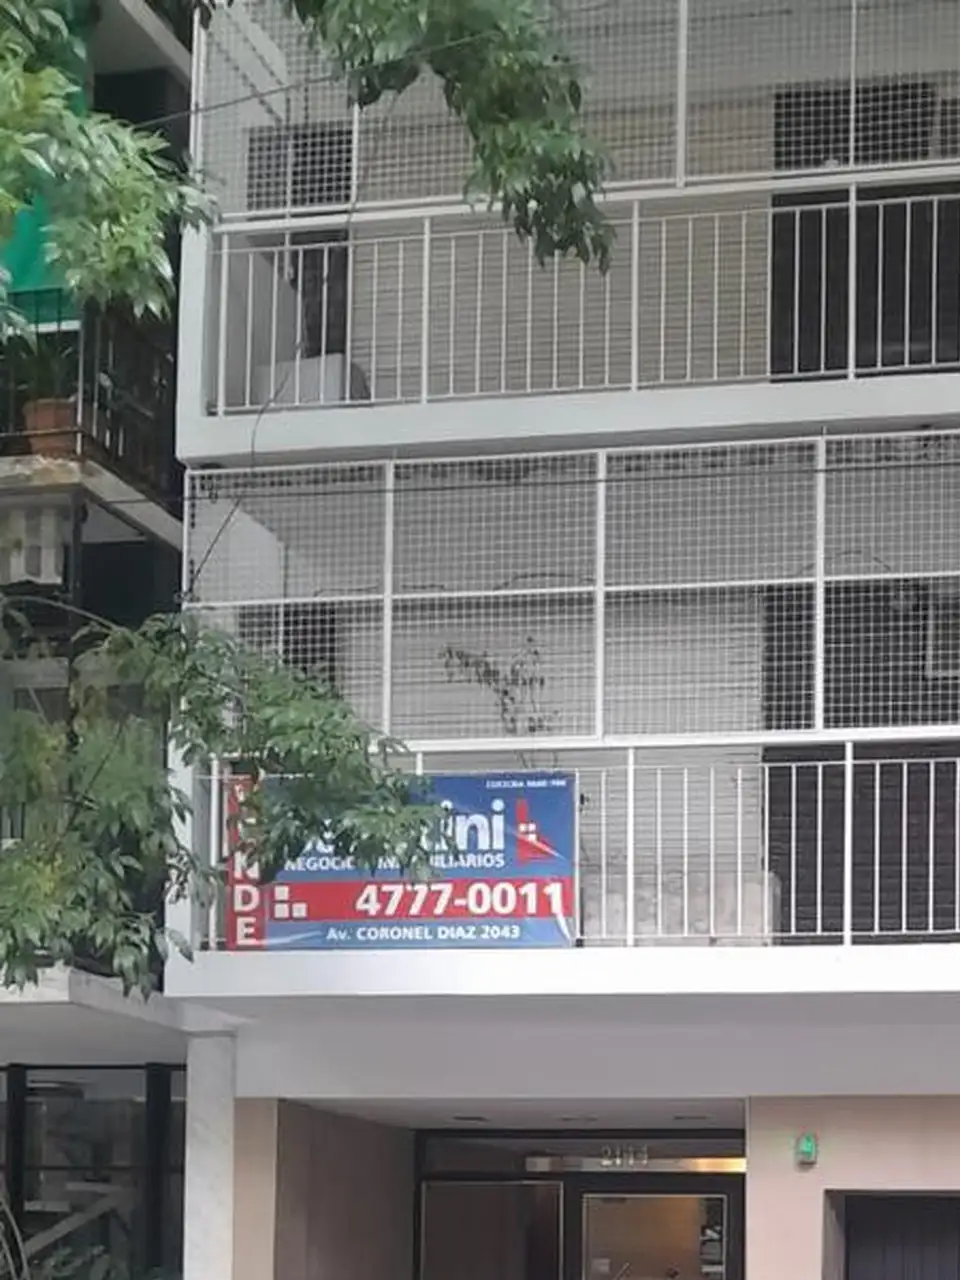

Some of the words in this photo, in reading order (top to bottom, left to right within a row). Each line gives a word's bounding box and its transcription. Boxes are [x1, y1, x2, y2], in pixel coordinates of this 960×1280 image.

[355, 881, 563, 917] 4777-0011
[356, 925, 433, 941] CORONEL
[437, 925, 477, 940] DIAZ
[480, 923, 521, 939] 2043
